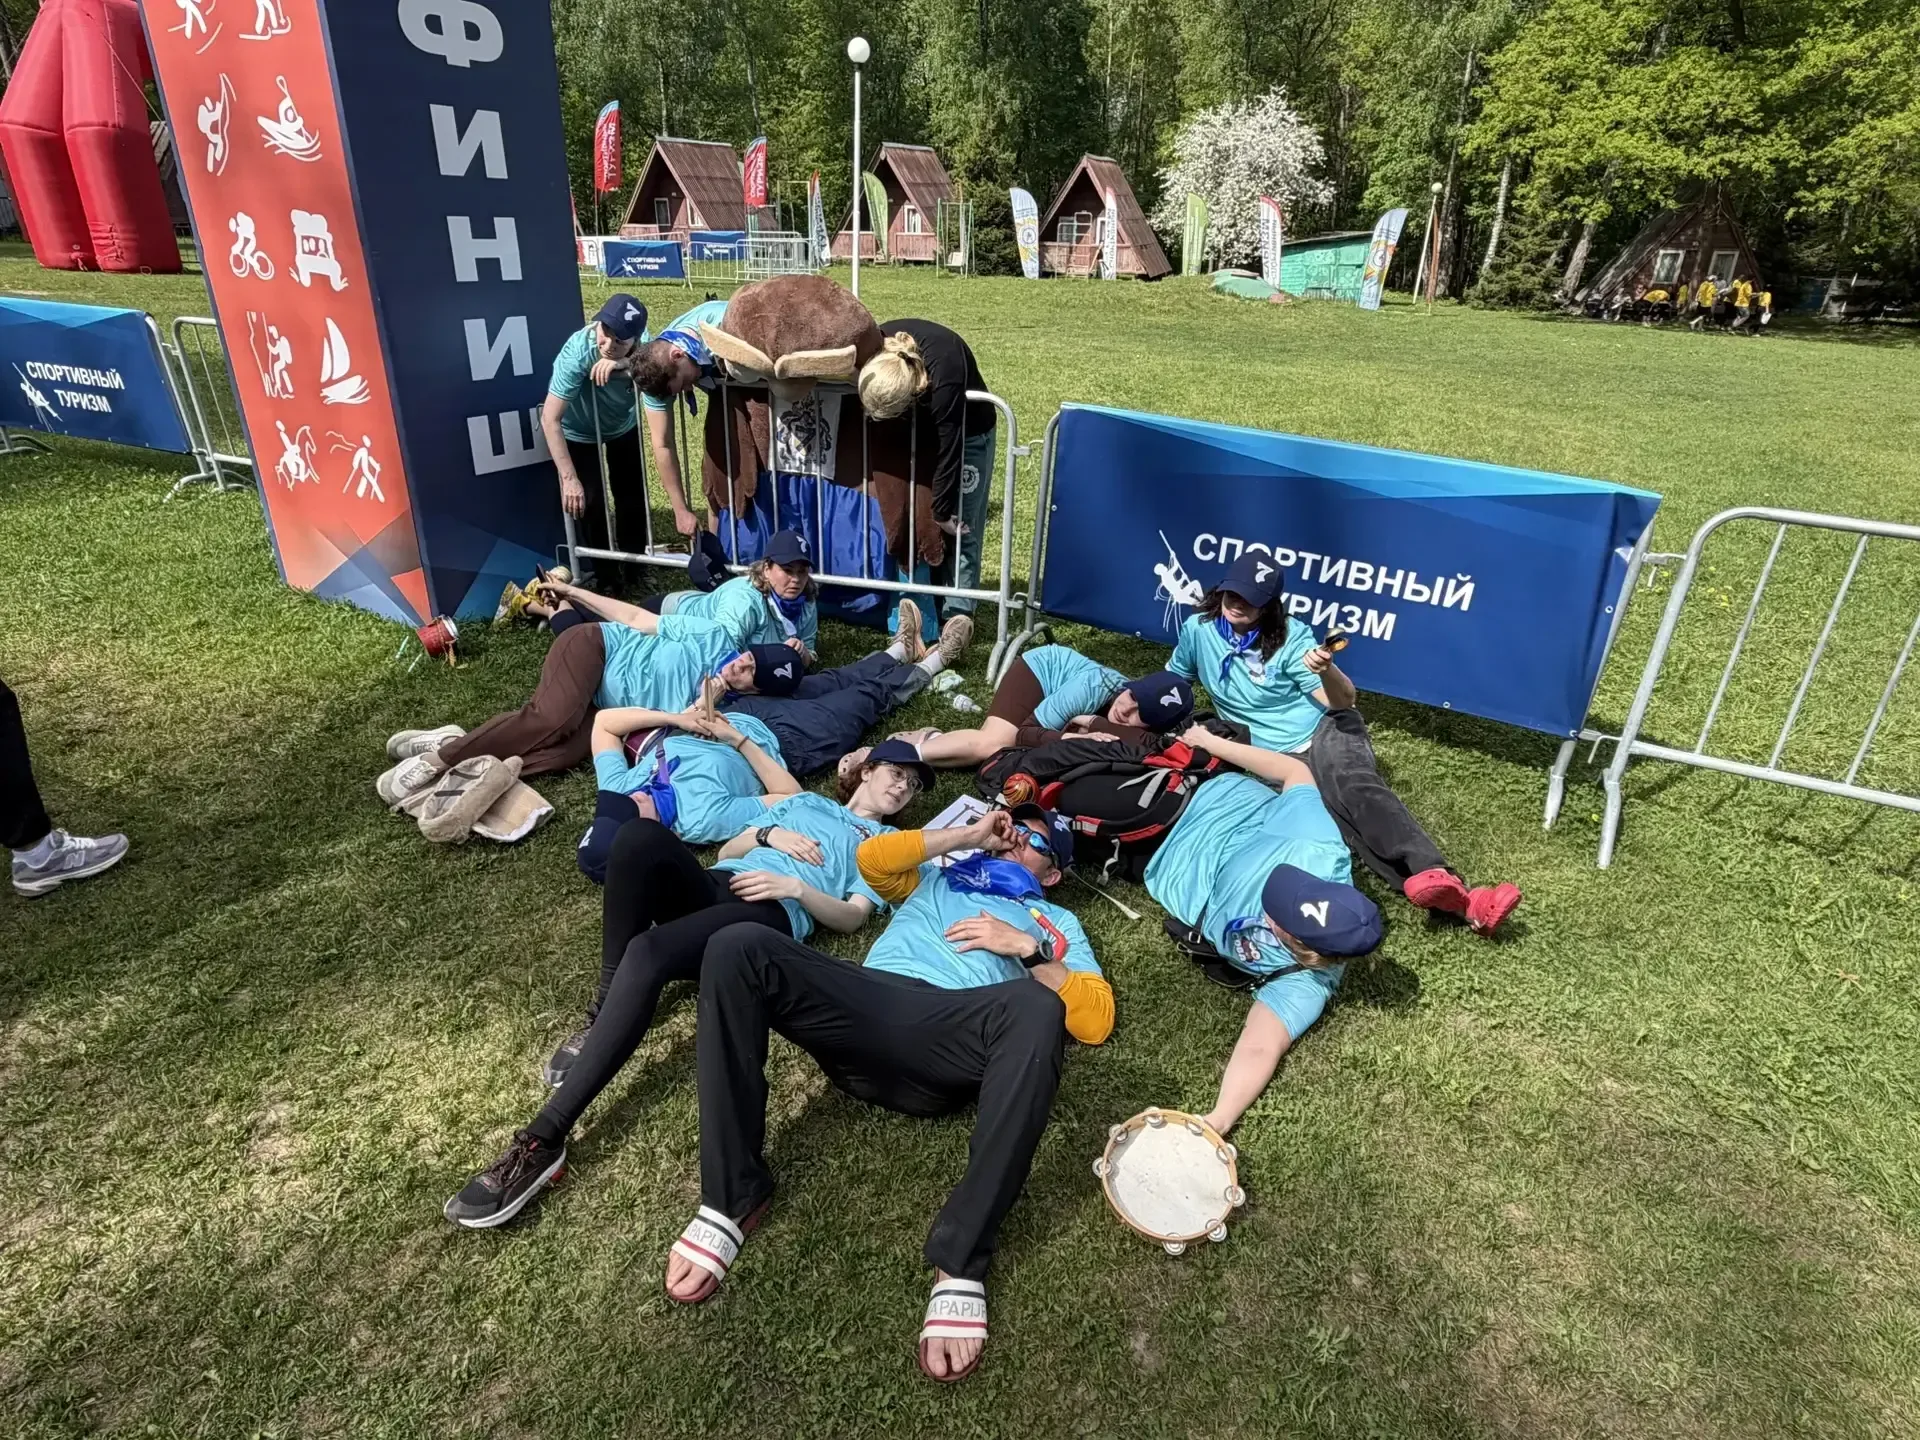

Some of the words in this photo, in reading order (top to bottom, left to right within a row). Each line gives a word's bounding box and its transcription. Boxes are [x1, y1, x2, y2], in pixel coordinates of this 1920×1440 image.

[398, 0, 552, 476] ФИНИШ
[26, 361, 125, 390] СПОРТИВНЫЙ
[54, 389, 112, 413] ТУРИЗМ
[1255, 561, 1274, 583] 7
[1281, 591, 1397, 641] РИЗМ
[688, 1223, 733, 1260] PAPIJRI
[929, 1300, 987, 1318] APAPIJ
